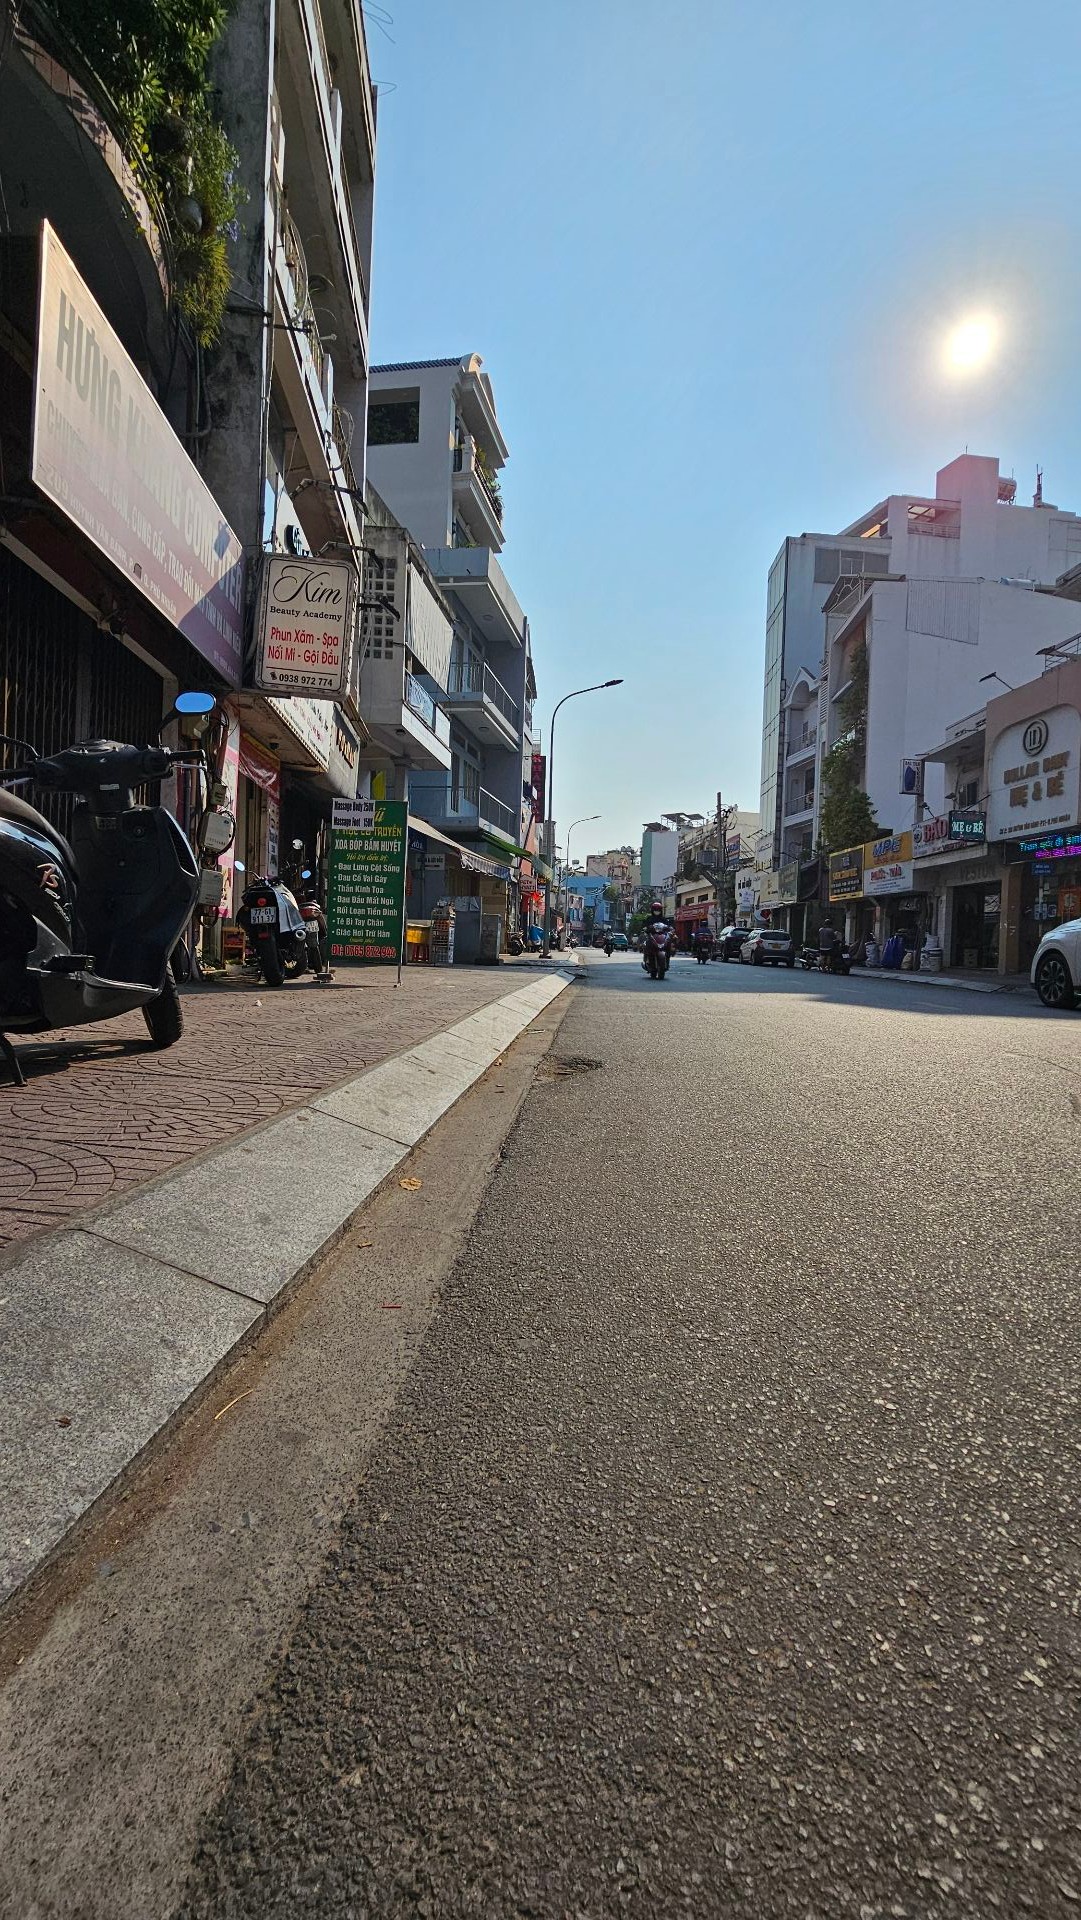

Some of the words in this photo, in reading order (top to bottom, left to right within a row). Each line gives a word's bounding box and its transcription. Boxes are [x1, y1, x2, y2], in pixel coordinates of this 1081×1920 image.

[56, 288, 121, 444] HƯNG
[168, 552, 184, 586] TRAO
[273, 565, 342, 604] Kim
[270, 606, 300, 617] Beauty
[303, 610, 342, 622] Academy
[271, 627, 292, 642] Phun
[294, 629, 314, 644] Xăm
[322, 632, 339, 648] Spa
[268, 645, 282, 660] Nối
[285, 647, 295, 662] Mi
[303, 649, 319, 666] Gội
[321, 649, 339, 665] Đầu
[278, 673, 298, 684] 0938
[301, 675, 316, 686] 972
[318, 677, 333, 687] 774
[334, 839, 348, 850] XOA
[364, 837, 379, 851] BẤM
[381, 840, 402, 854] HUYỆT
[338, 862, 351, 871] Đau
[383, 863, 400, 873] Sống
[363, 875, 373, 883] Vai
[355, 885, 371, 893] Kinh
[355, 918, 366, 927] Tay
